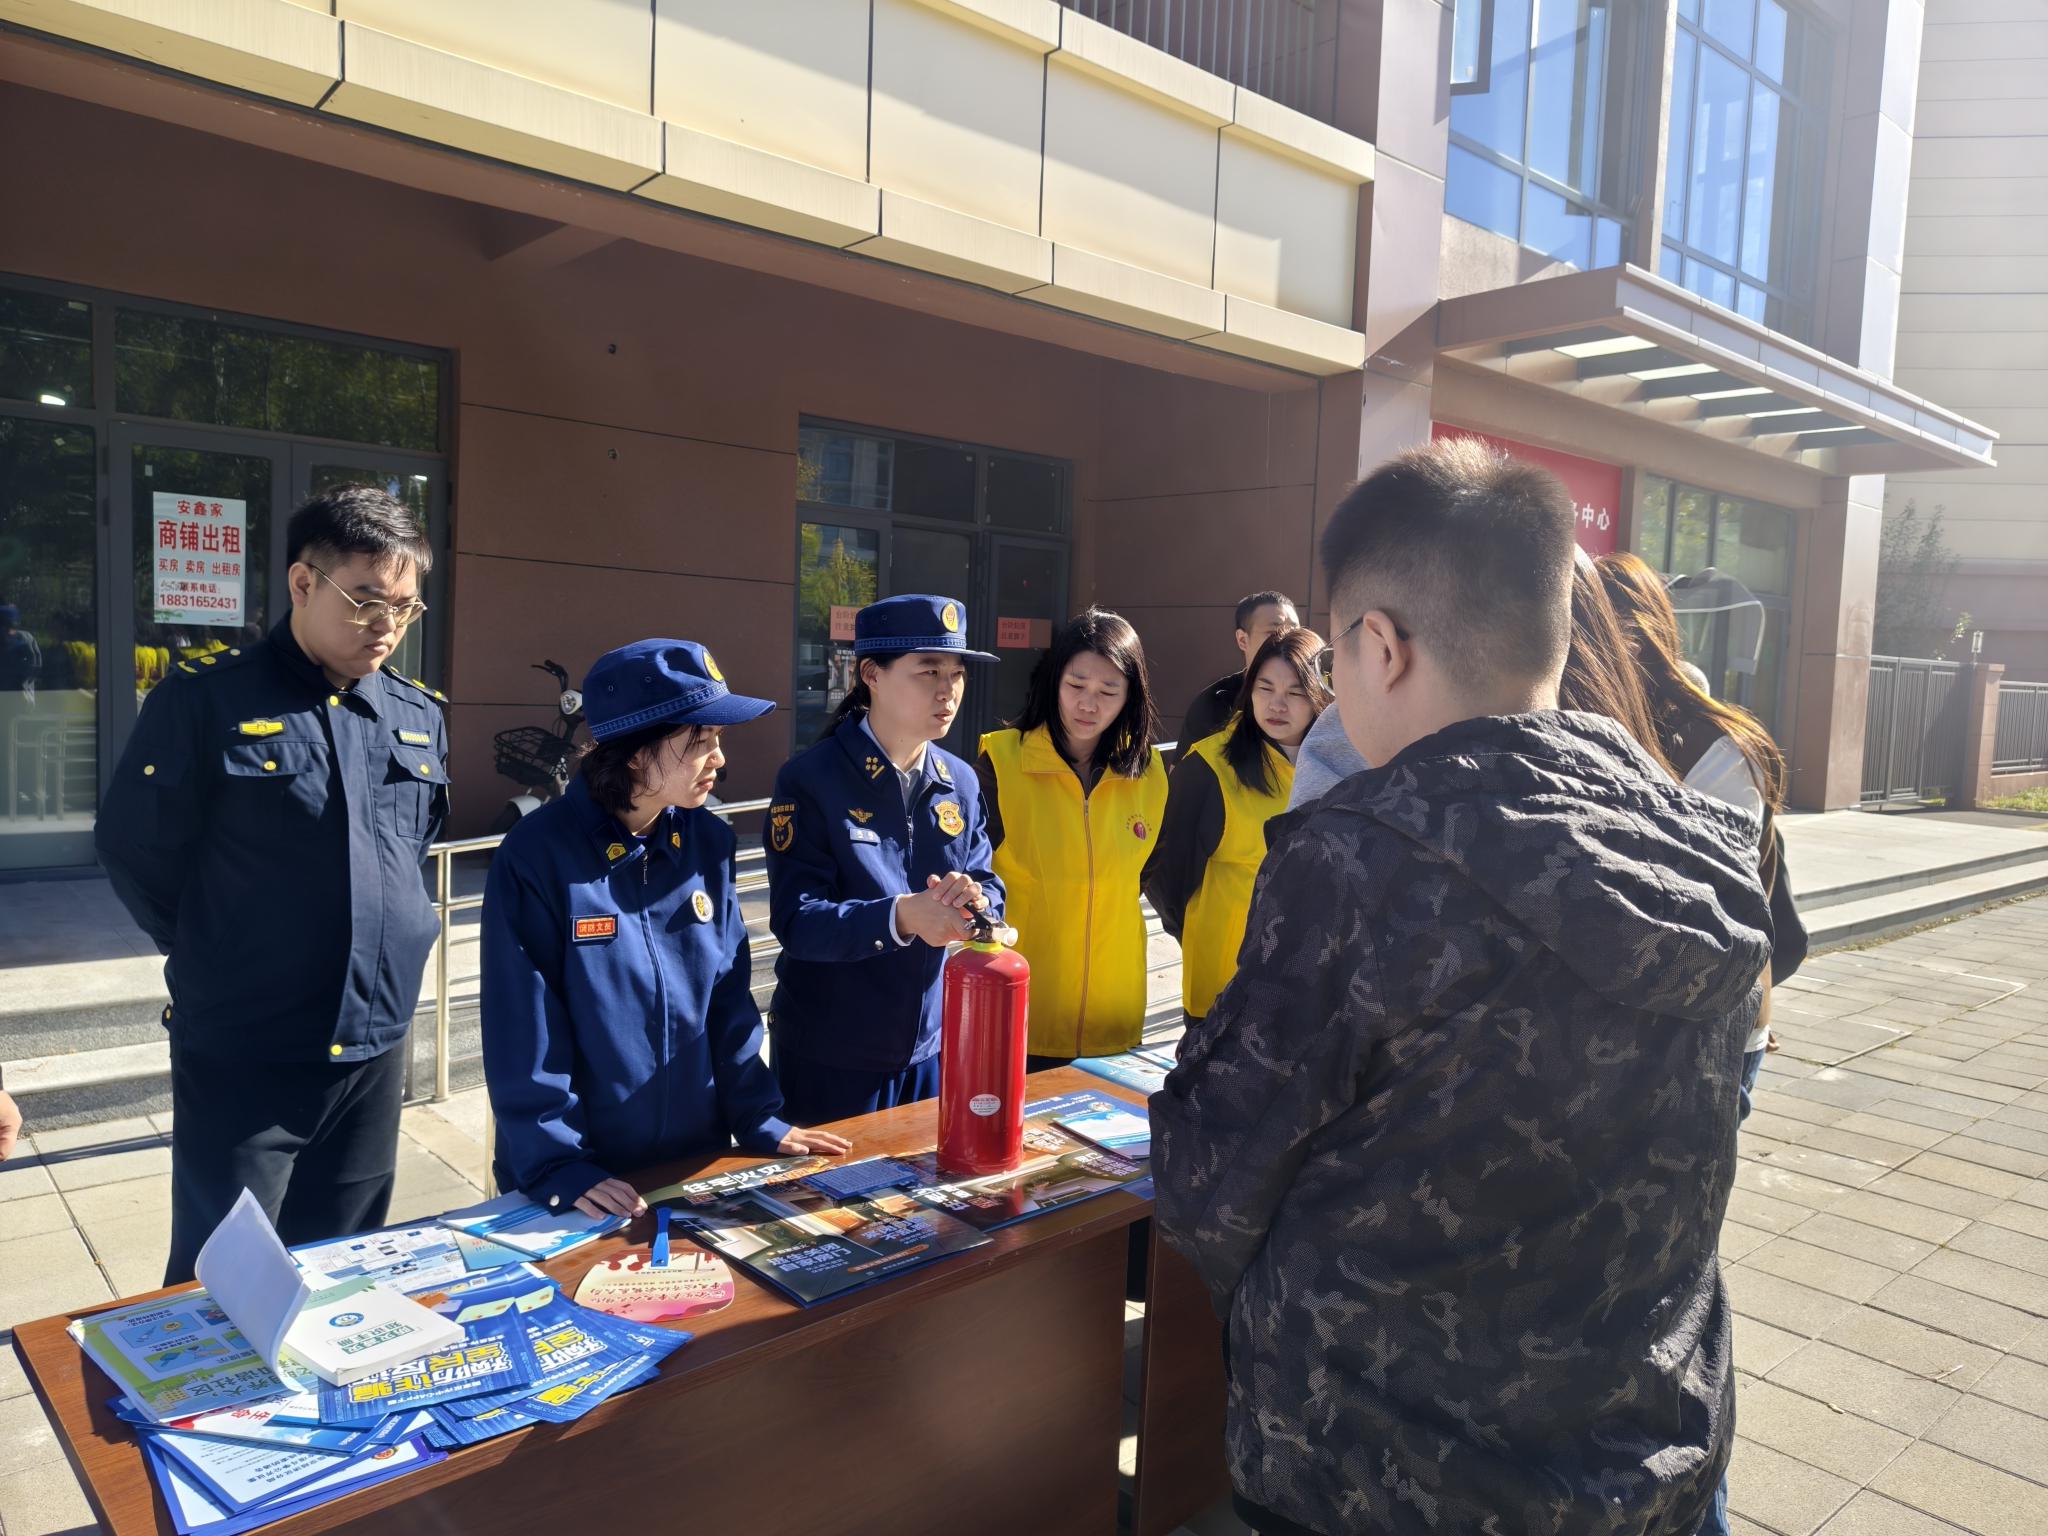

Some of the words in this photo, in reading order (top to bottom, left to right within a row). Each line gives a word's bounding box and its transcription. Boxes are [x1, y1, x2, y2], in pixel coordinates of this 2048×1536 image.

[177, 499, 224, 518] 安鑫家
[158, 519, 241, 554] 商铺出租
[159, 558, 179, 573] 买房
[186, 559, 205, 575] 卖房
[212, 562, 241, 577] 出租房
[160, 594, 238, 610] 18831652431
[352, 1358, 511, 1402] 预防诈骗
